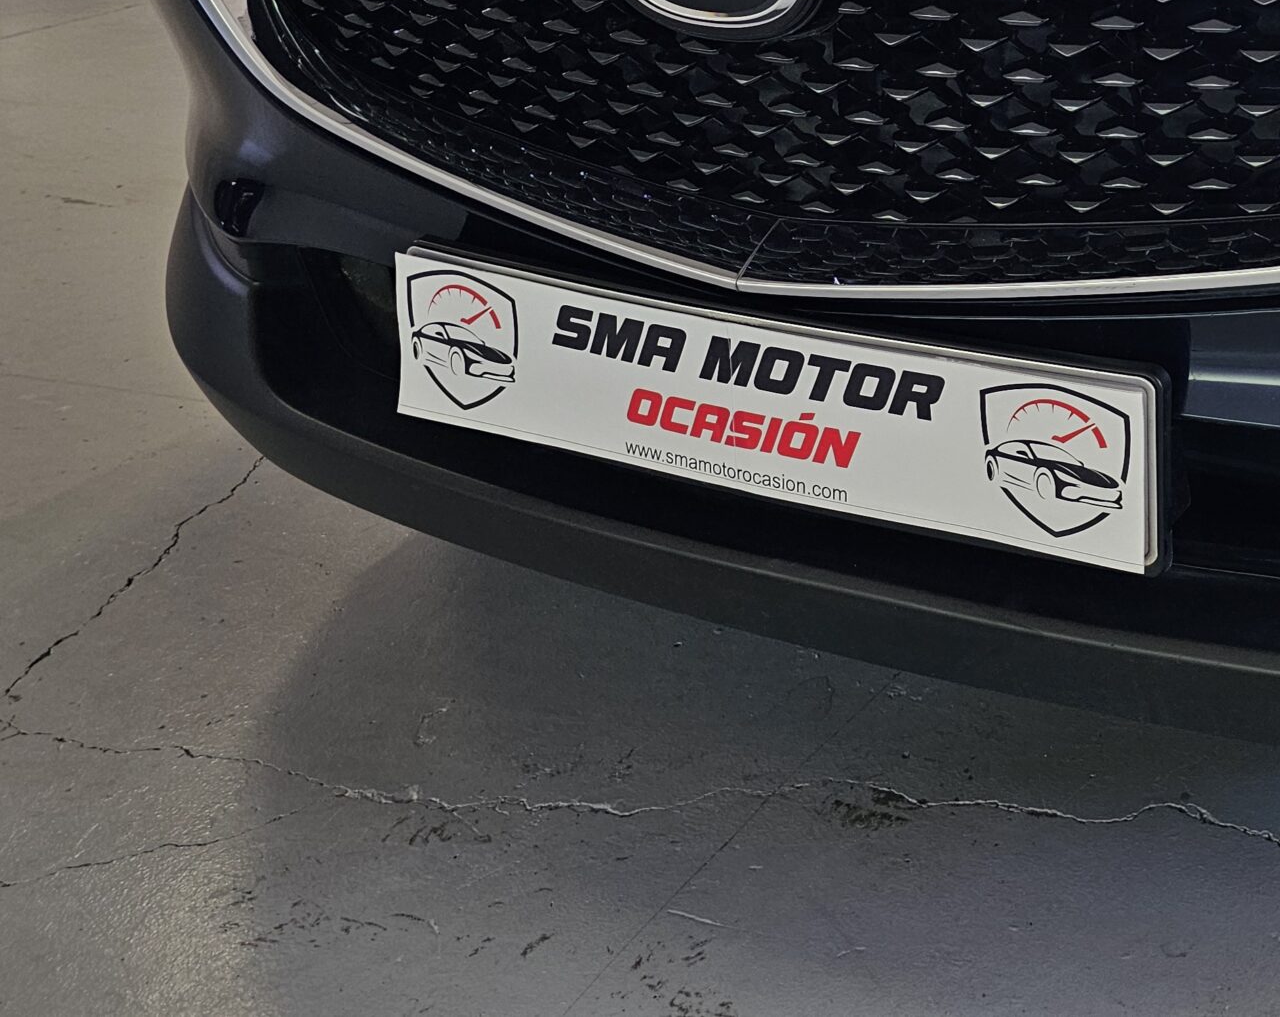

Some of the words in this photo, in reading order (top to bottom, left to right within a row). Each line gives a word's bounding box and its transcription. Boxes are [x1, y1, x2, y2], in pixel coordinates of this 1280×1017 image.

[552, 304, 687, 373] SMA
[699, 335, 946, 422] MOTOR
[626, 387, 862, 469] OCASIÓN
[625, 441, 849, 503] www.smamotorocasion.com
